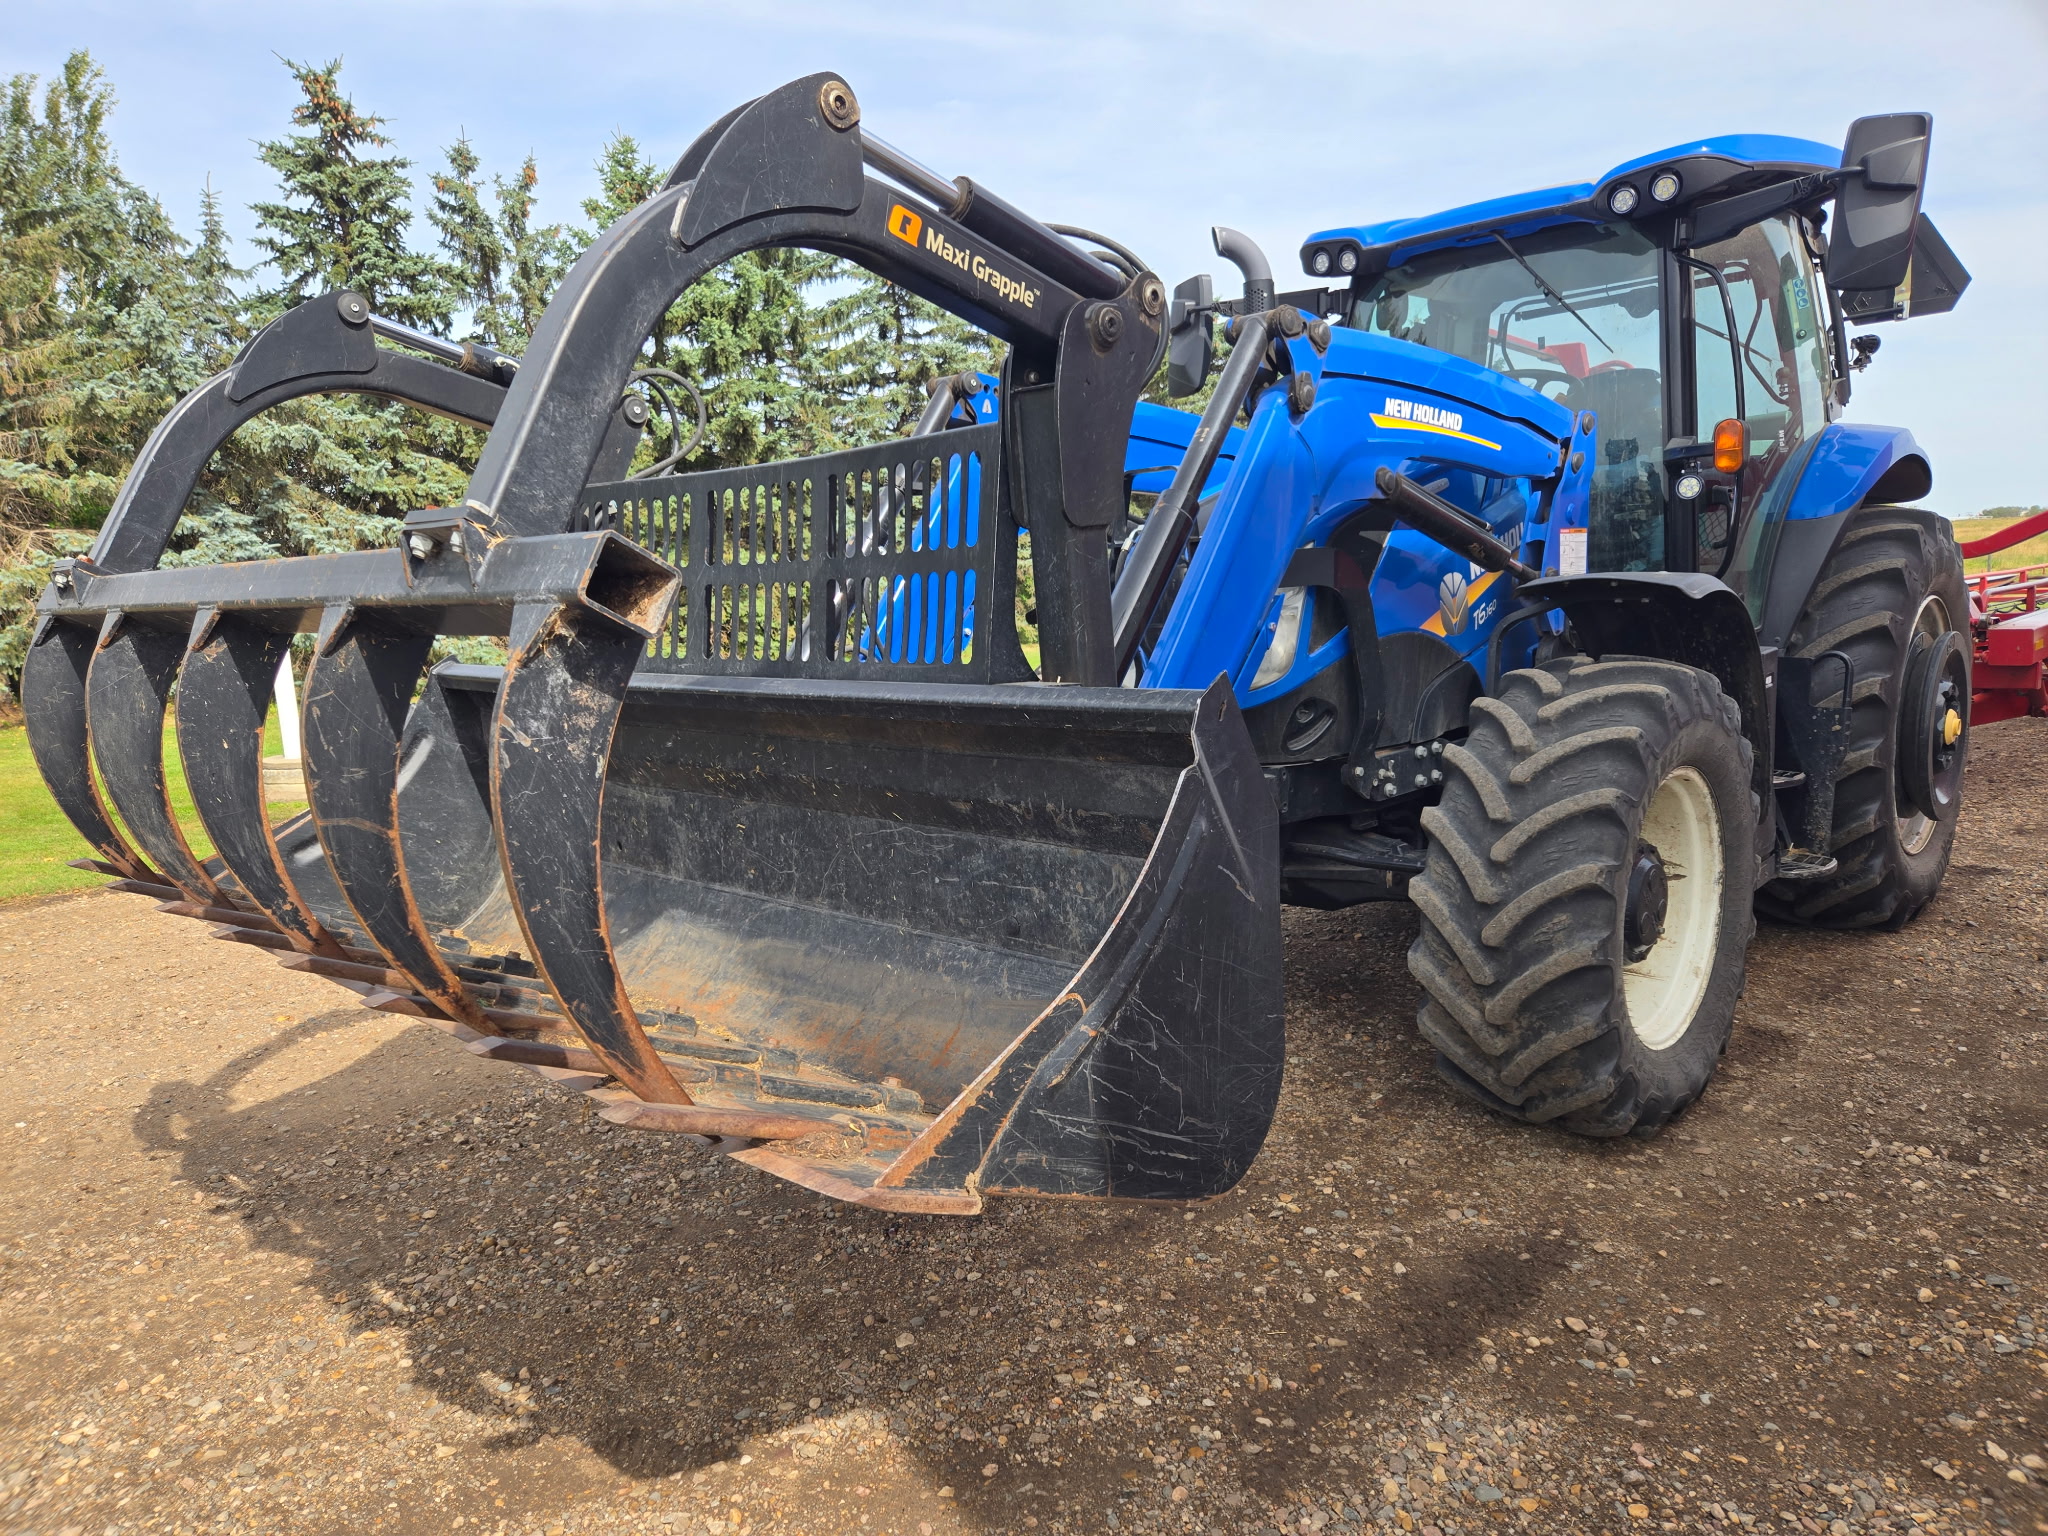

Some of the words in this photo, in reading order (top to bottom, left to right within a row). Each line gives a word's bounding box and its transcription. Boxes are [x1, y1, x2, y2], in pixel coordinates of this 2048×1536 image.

[925, 227, 970, 271] Maxi
[1385, 397, 1412, 420] NEW
[1413, 402, 1463, 431] HOLLAND
